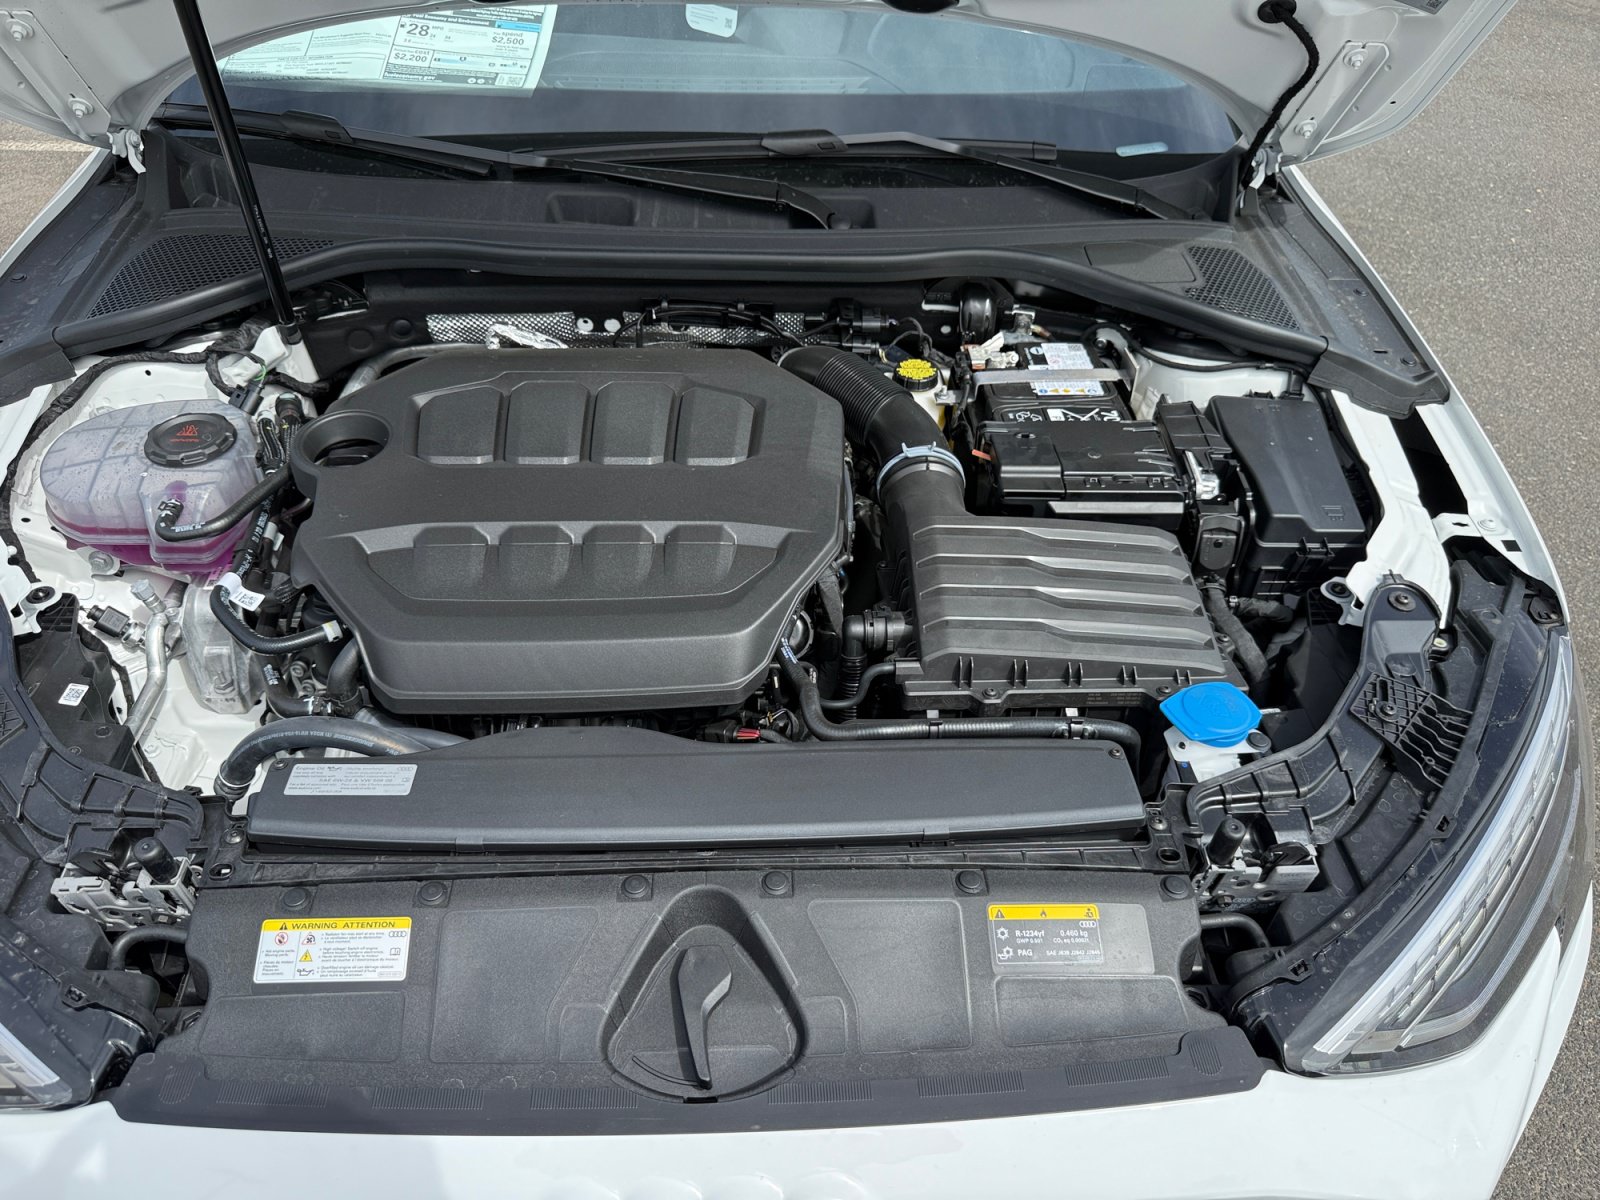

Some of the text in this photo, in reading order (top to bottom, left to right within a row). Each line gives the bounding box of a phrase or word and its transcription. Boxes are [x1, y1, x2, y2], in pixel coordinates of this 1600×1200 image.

[406, 23, 430, 37] 28
[491, 36, 525, 46] $2,500
[393, 52, 427, 62] $2,200
[384, 72, 435, 81] fueleconomy.gov
[292, 921, 395, 930] WARNING ATTENTION
[1015, 929, 1045, 937] R-1234yf
[1079, 929, 1088, 937] kg
